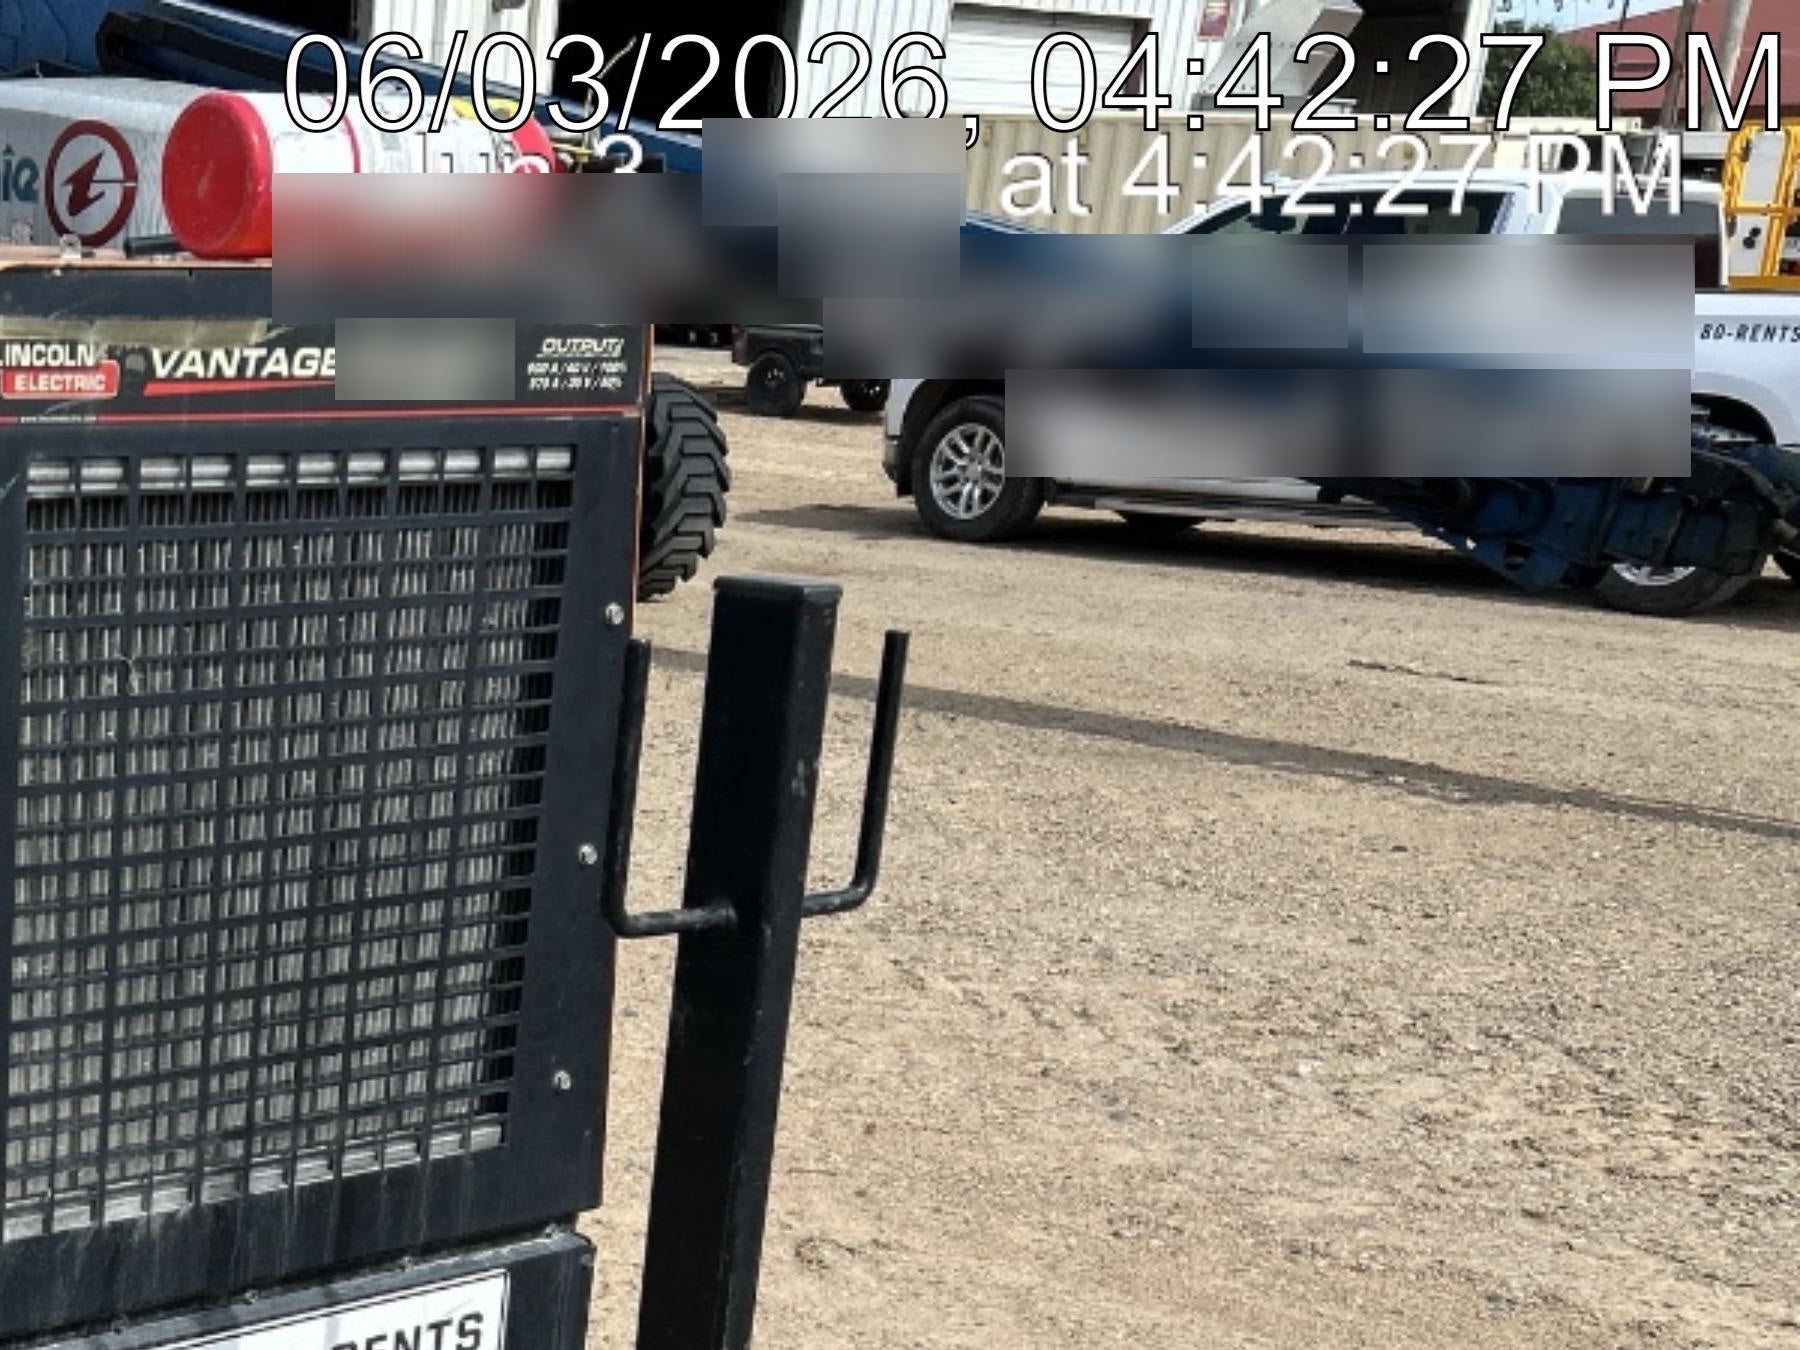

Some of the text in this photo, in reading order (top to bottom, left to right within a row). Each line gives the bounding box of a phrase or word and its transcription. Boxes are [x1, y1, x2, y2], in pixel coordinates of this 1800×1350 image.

[1700, 322, 1800, 343] 80-RENTS
[151, 347, 335, 378] VANTAGE
[14, 373, 106, 391] ELECTRIC
